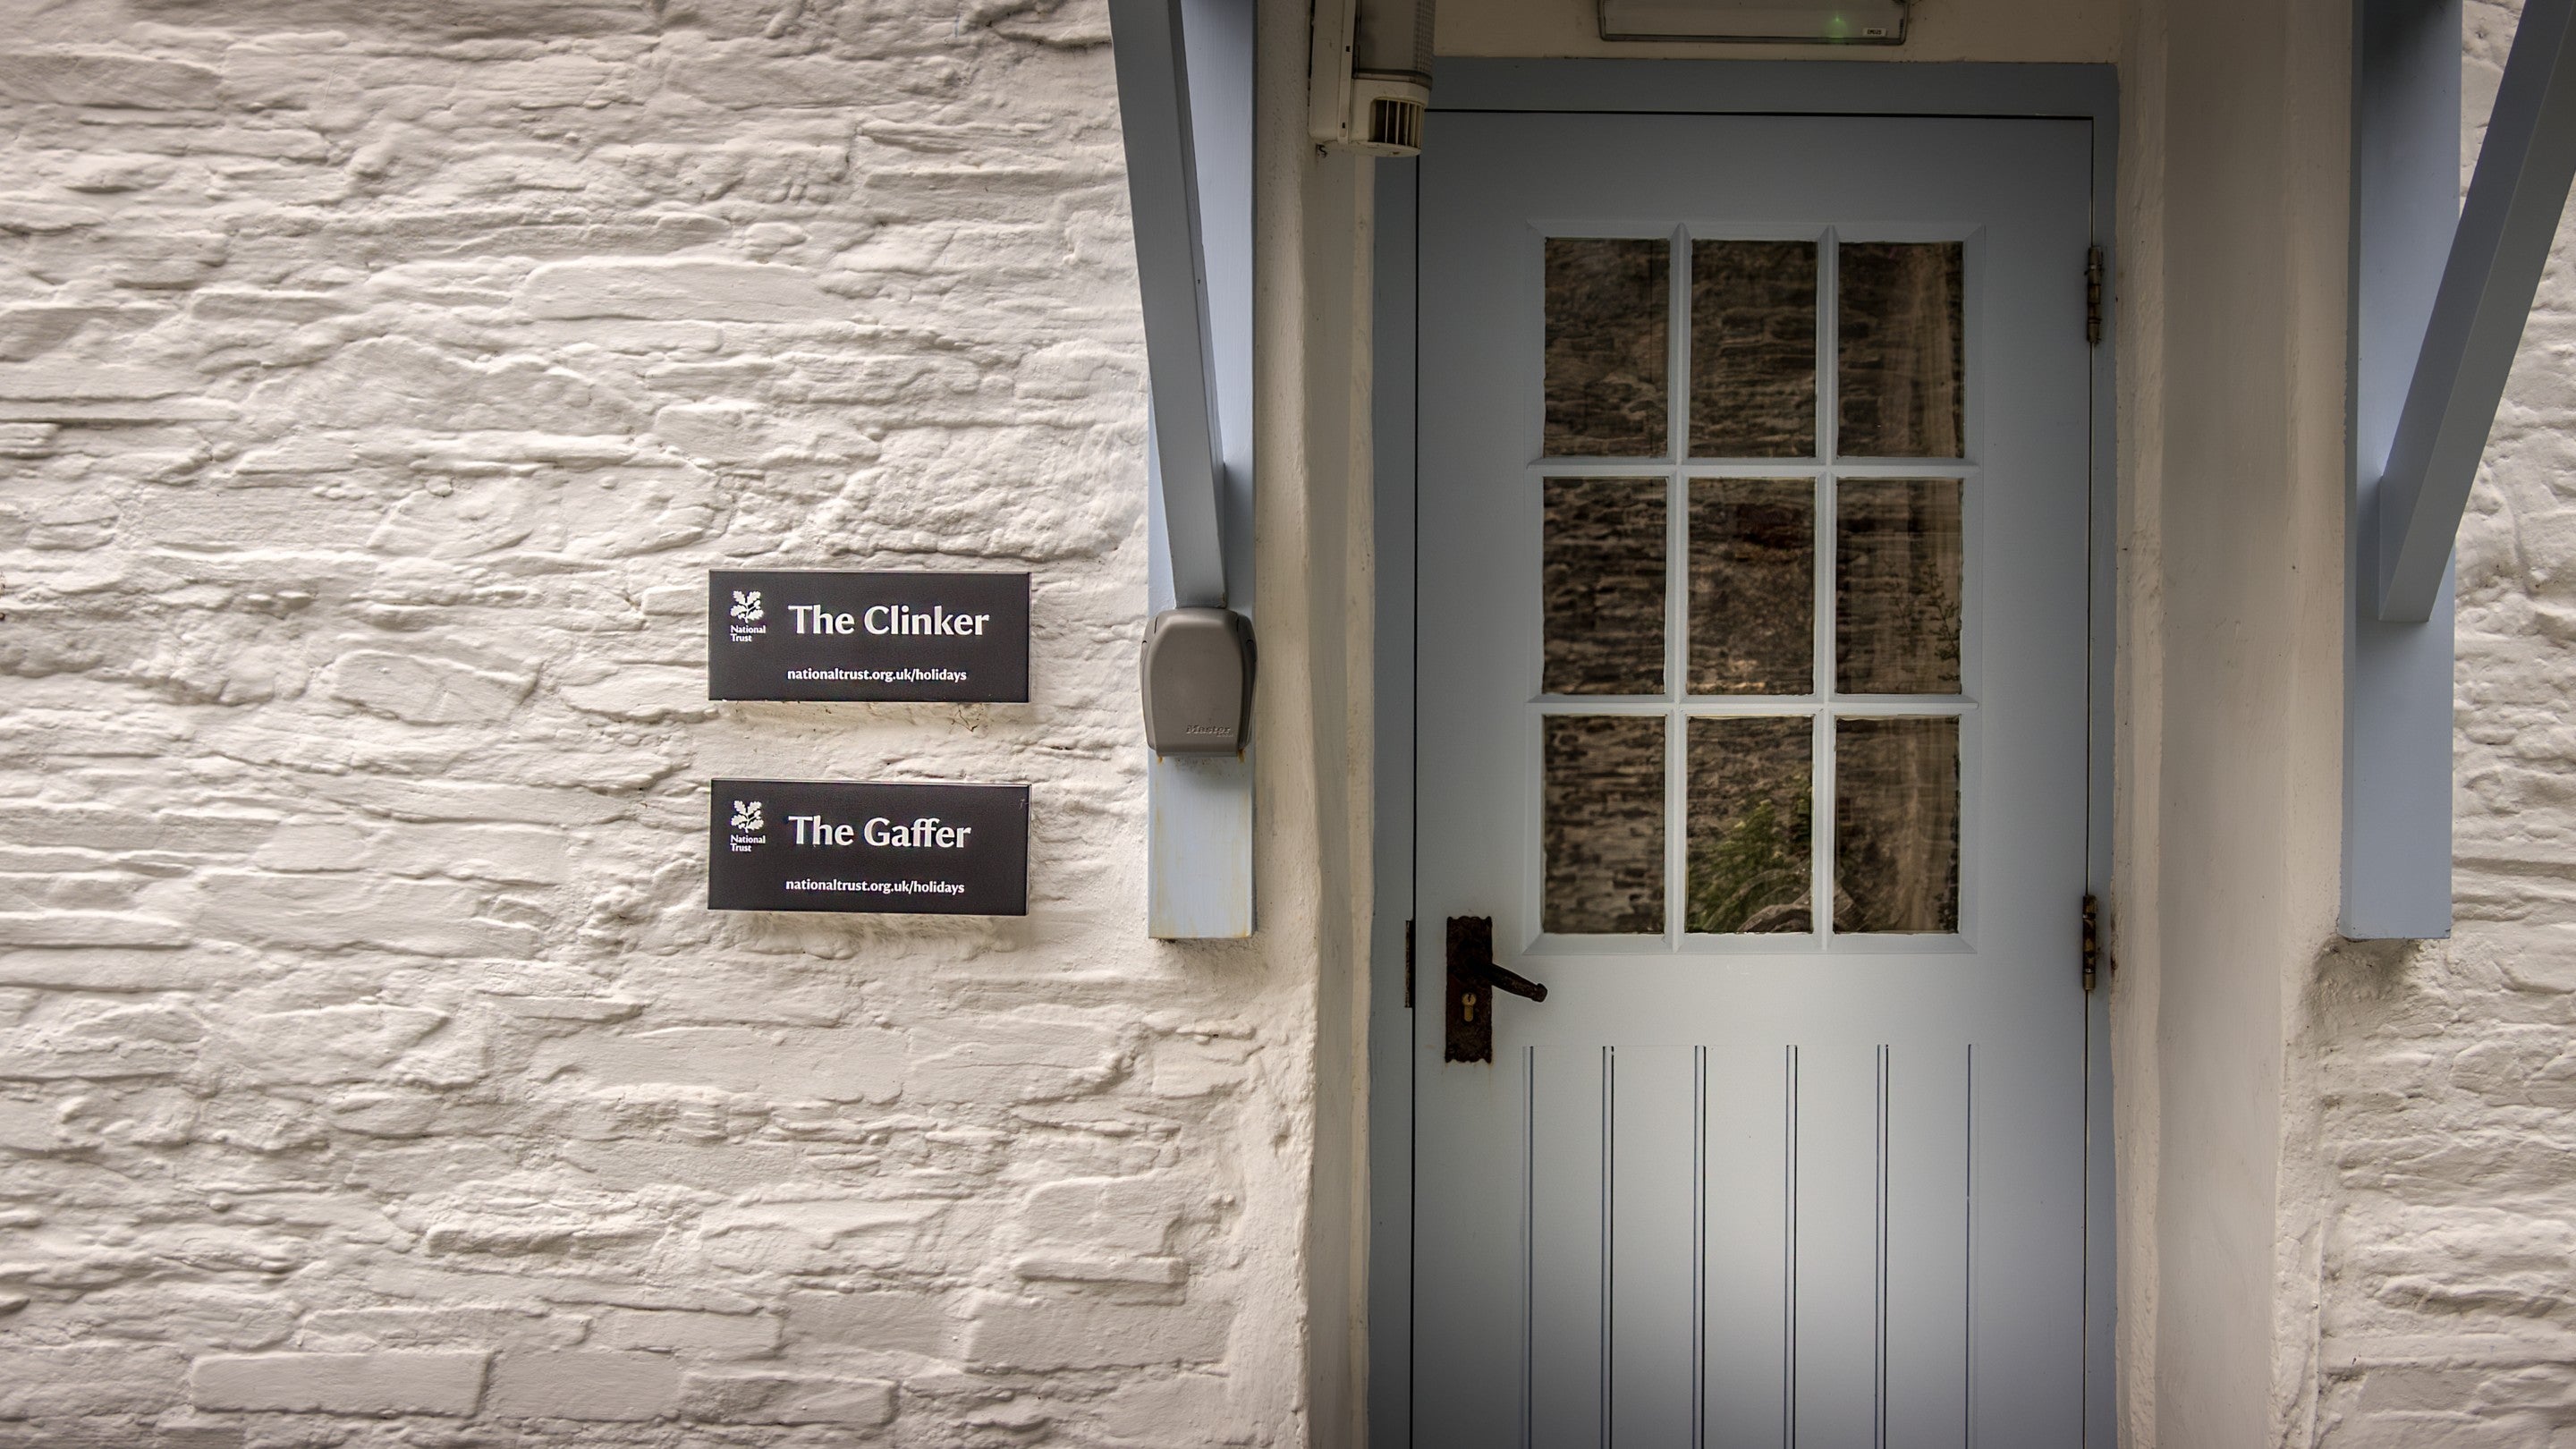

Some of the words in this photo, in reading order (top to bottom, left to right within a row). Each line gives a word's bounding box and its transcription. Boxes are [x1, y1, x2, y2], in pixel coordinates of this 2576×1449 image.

[788, 605, 854, 634] The
[864, 606, 989, 636] Clinker
[731, 625, 766, 634] National
[730, 634, 752, 642] Trust
[787, 668, 967, 682] nationaltrust.org.uk/holidays
[788, 815, 853, 845] The
[864, 817, 971, 848] Gaffer
[730, 835, 766, 844] National
[730, 843, 751, 852] Trust
[785, 878, 965, 894] nationaltrust.org.uk/holidays
